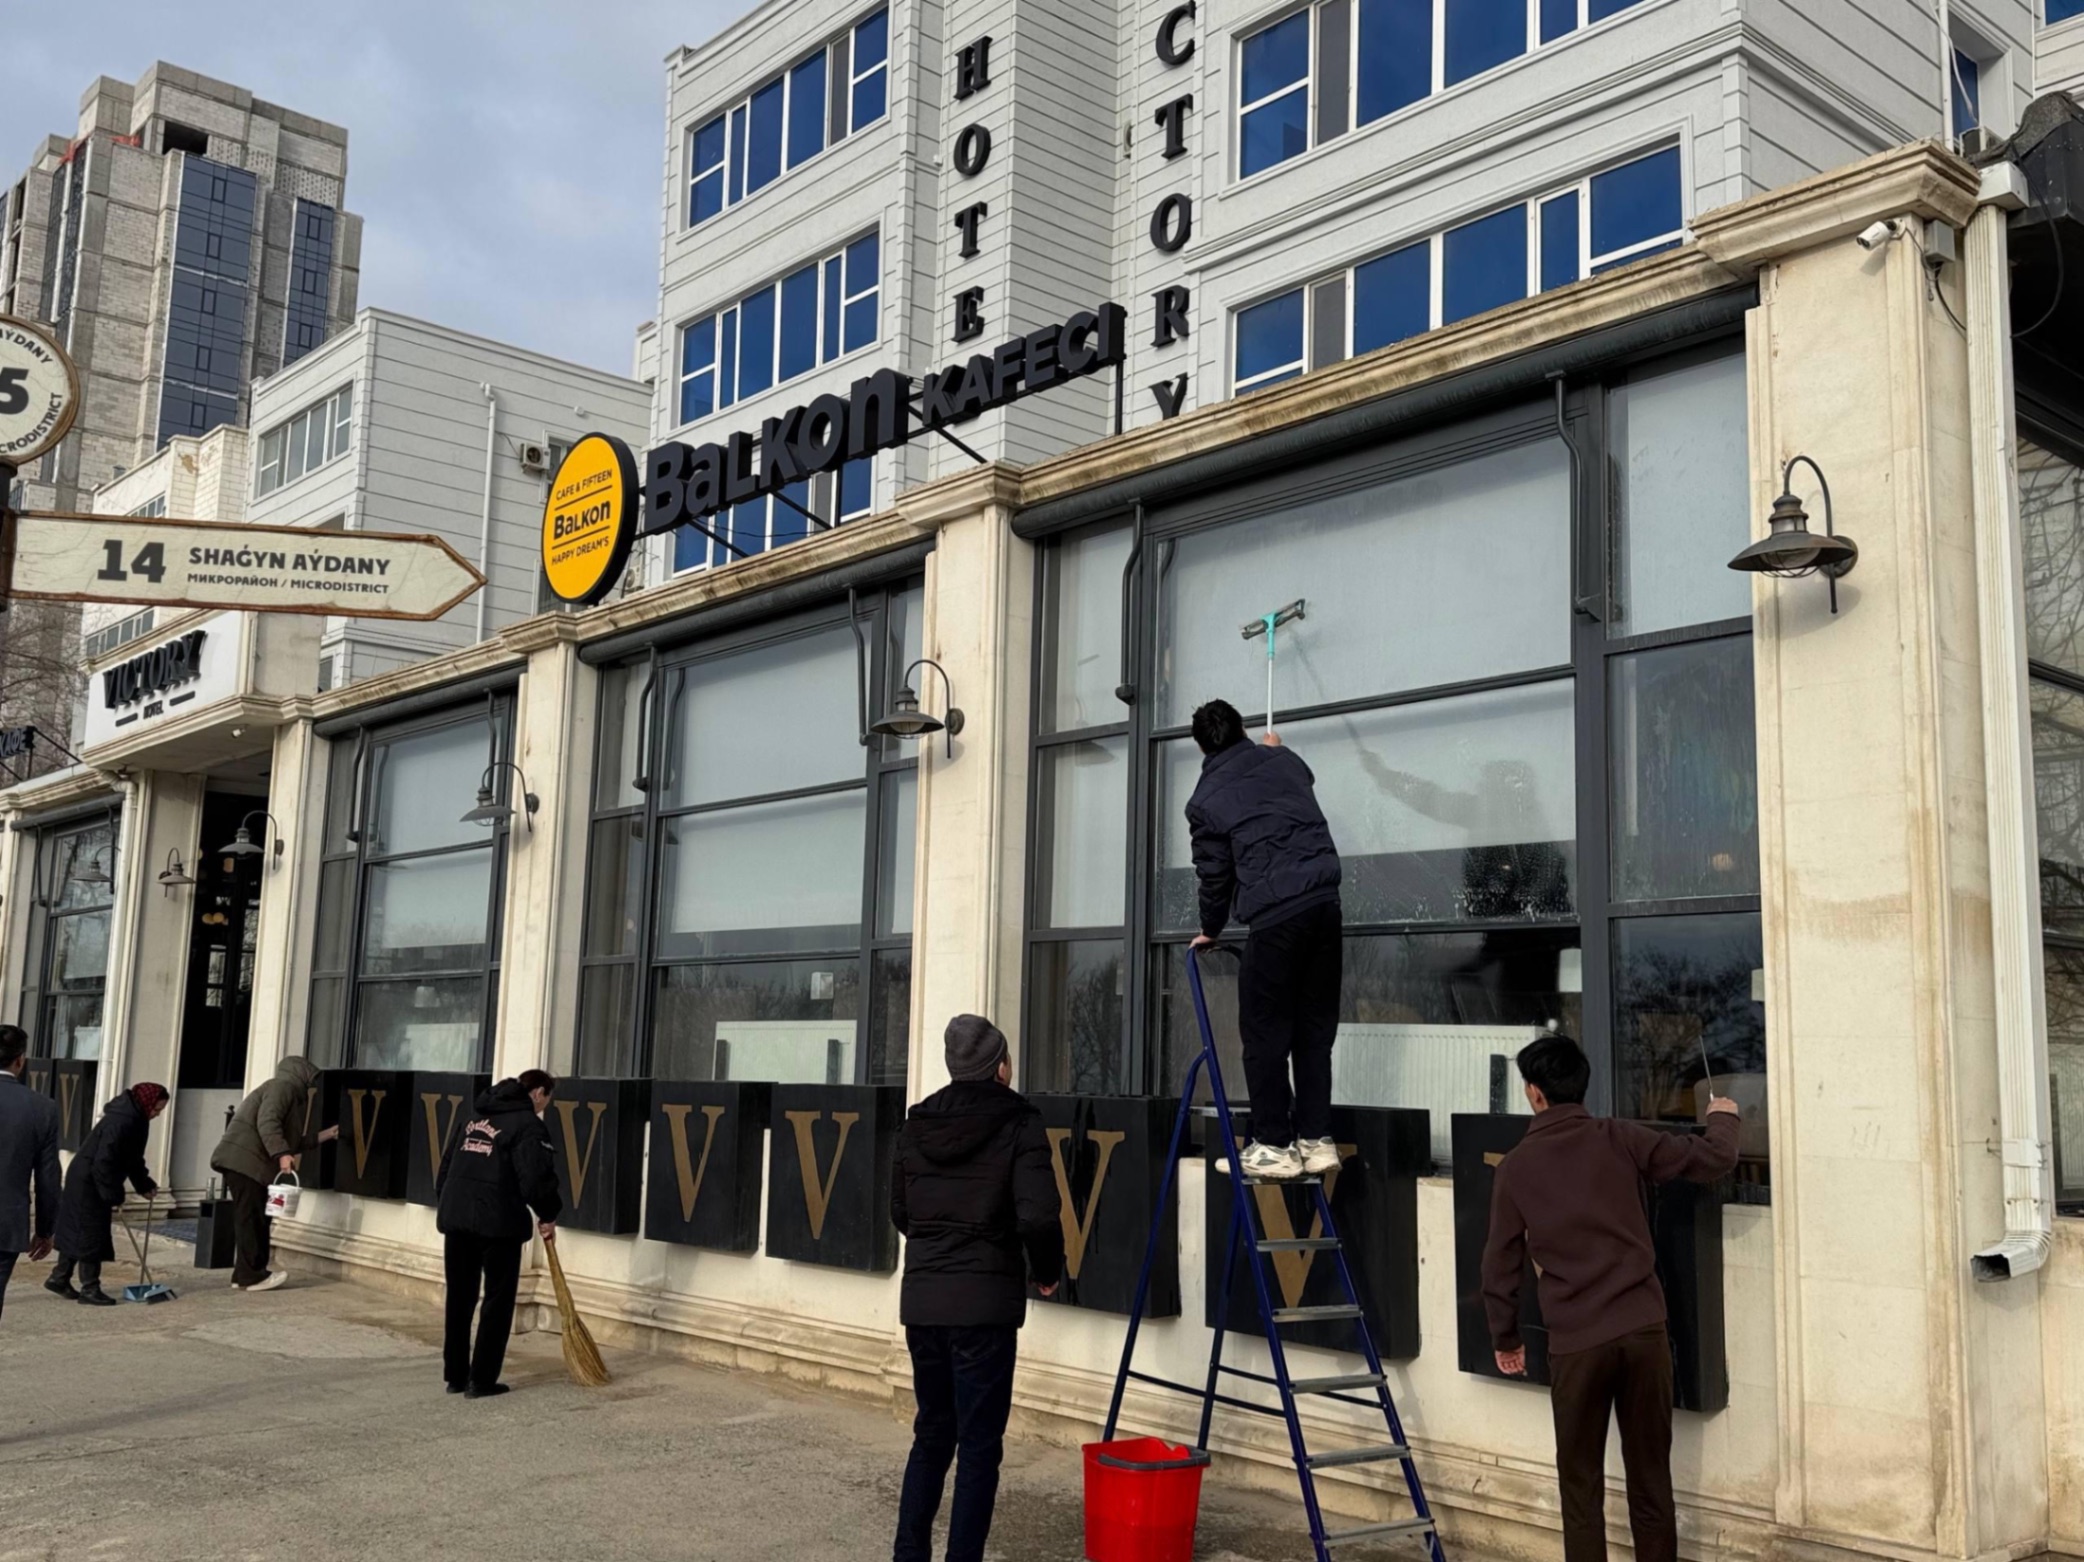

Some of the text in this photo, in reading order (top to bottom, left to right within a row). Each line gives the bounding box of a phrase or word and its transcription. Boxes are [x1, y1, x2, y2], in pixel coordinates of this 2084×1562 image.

[922, 301, 1125, 427] KAFECI
[557, 485, 574, 500] CAFE
[582, 470, 612, 488] FIFTEEN
[97, 539, 167, 583] 14
[187, 572, 278, 588] МИКРОРАЙОН
[290, 579, 390, 594] MICRODISTRICT
[292, 548, 391, 576] AÝDANY
[551, 550, 575, 565] HAPPY
[103, 630, 206, 709] VICTORY
[348, 1089, 386, 1179] V
[553, 1100, 607, 1209] V
[662, 1104, 725, 1222] V
[785, 1110, 860, 1240] V
[1046, 1128, 1125, 1279] V
